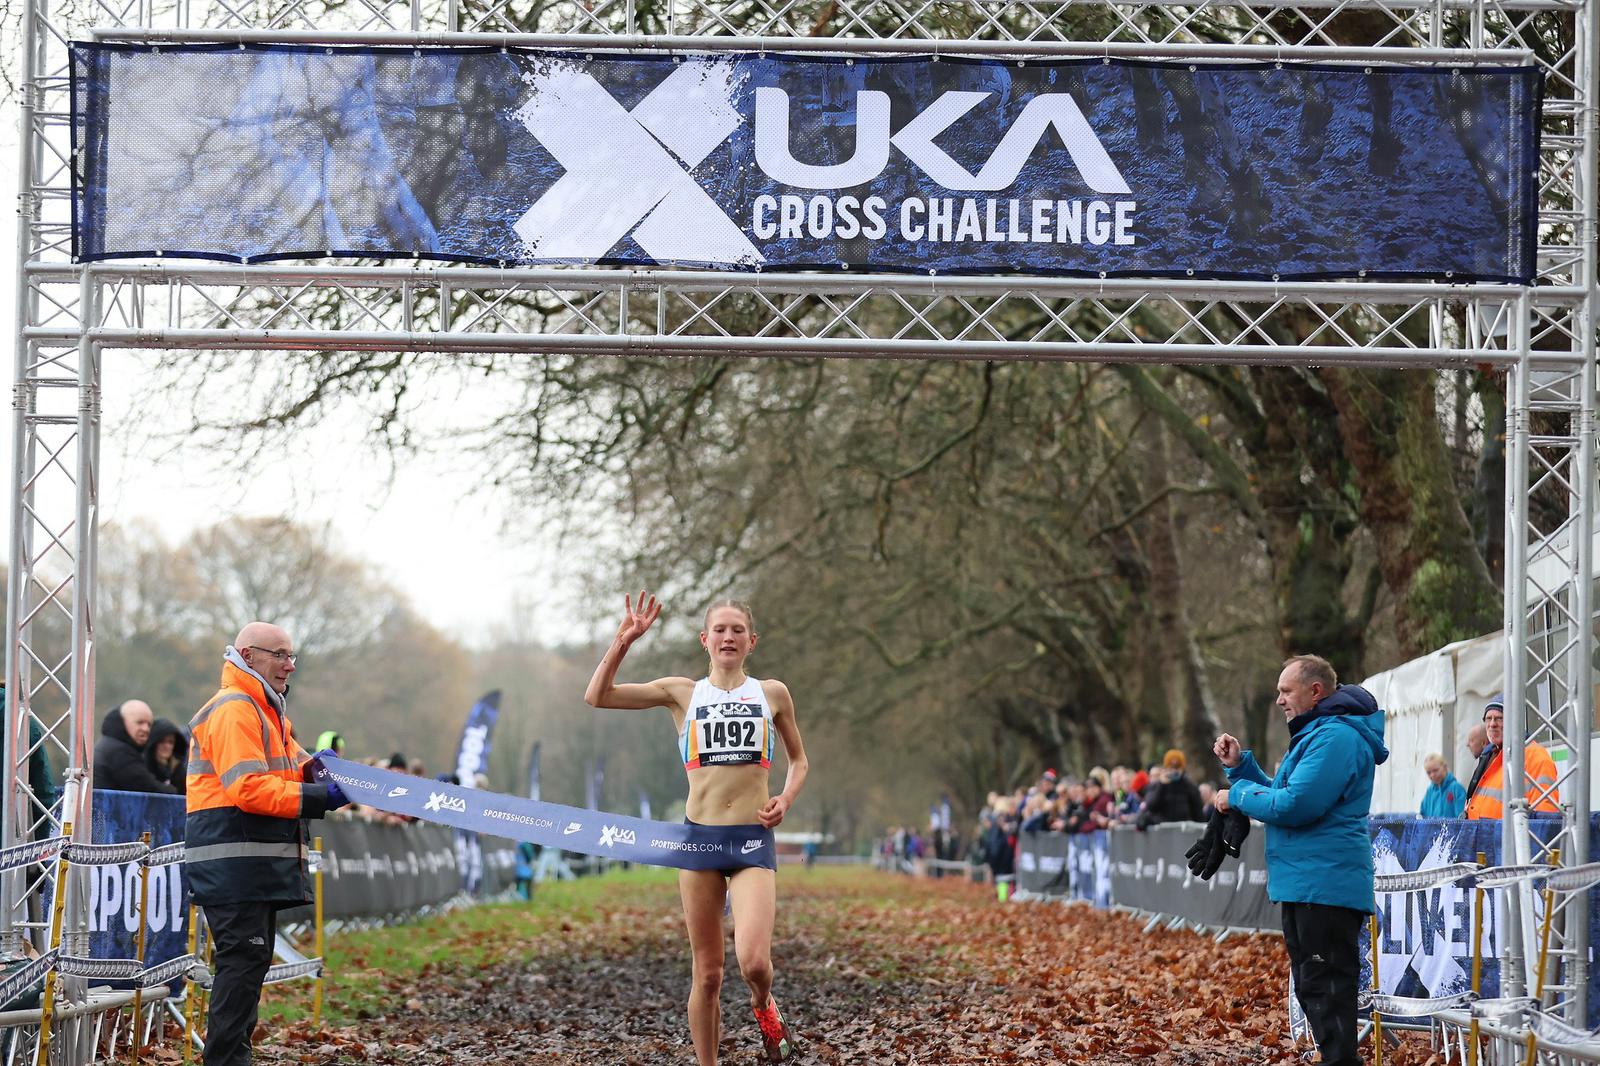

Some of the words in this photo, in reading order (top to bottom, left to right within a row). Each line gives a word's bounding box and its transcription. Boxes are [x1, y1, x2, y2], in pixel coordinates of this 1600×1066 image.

[754, 86, 1132, 194] UKA
[752, 194, 887, 241] CROSS
[899, 196, 1137, 246] CHALLENGE
[722, 704, 752, 712] UKA
[703, 721, 756, 749] 1492
[483, 809, 553, 829] SPORTSSHOES.COM
[651, 839, 723, 852] SPORTSSHOES.COM
[744, 839, 763, 848] RUN
